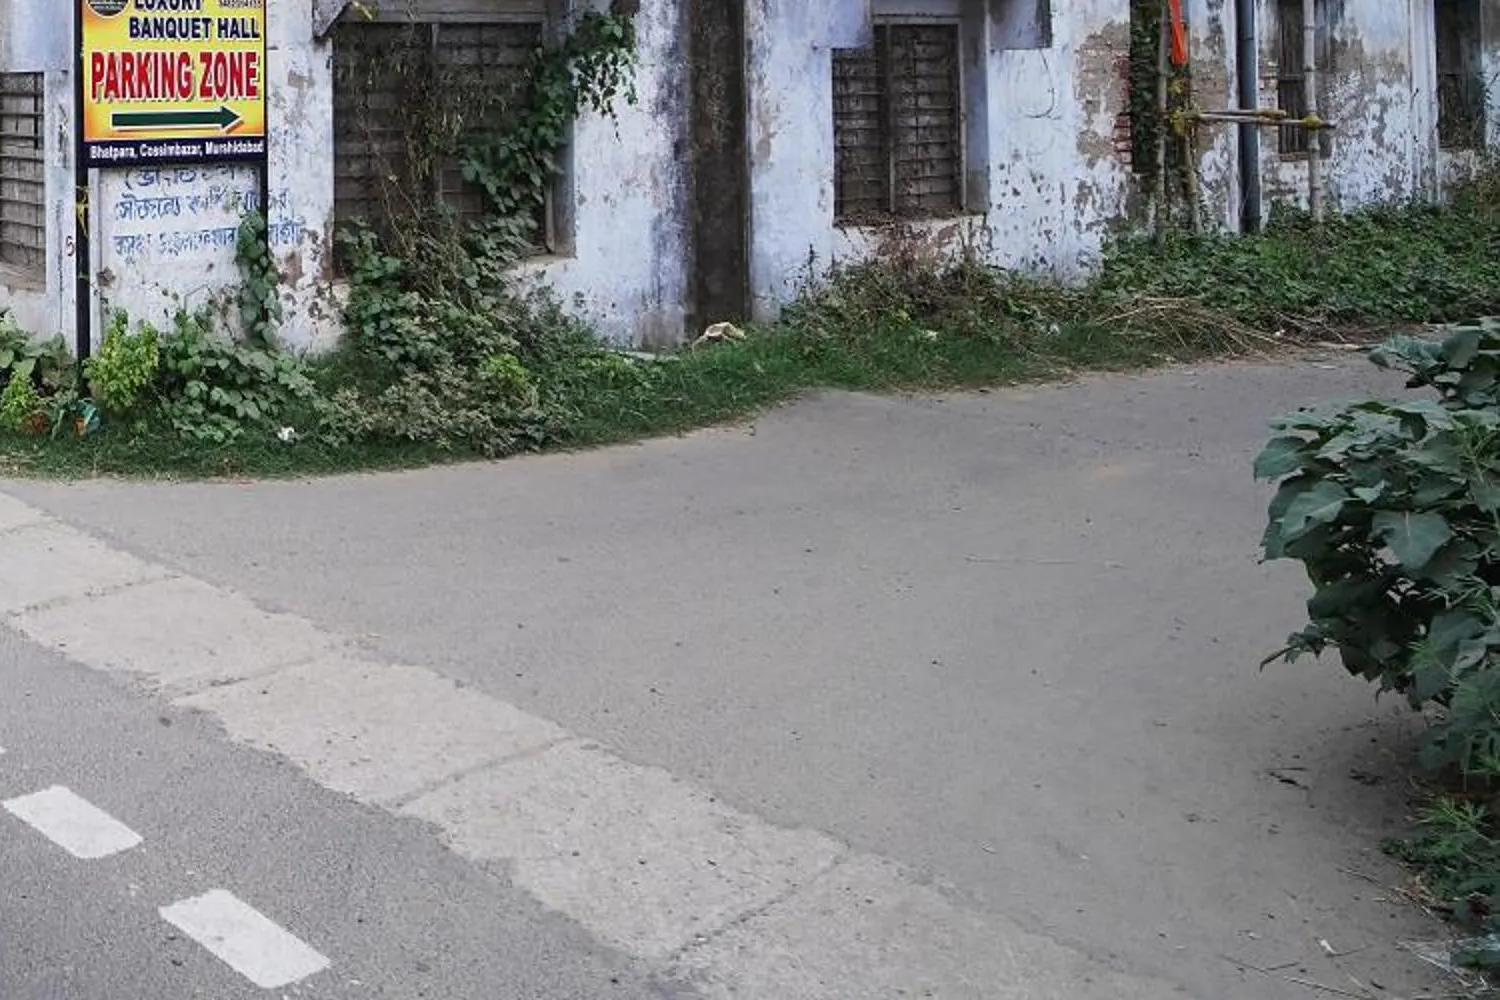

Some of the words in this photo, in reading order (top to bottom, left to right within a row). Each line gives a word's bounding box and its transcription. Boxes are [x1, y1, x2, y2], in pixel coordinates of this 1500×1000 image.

[129, 17, 211, 39] BANQUET
[217, 17, 260, 38] HALL
[91, 51, 192, 100] PARKING
[199, 51, 259, 98] ZONE
